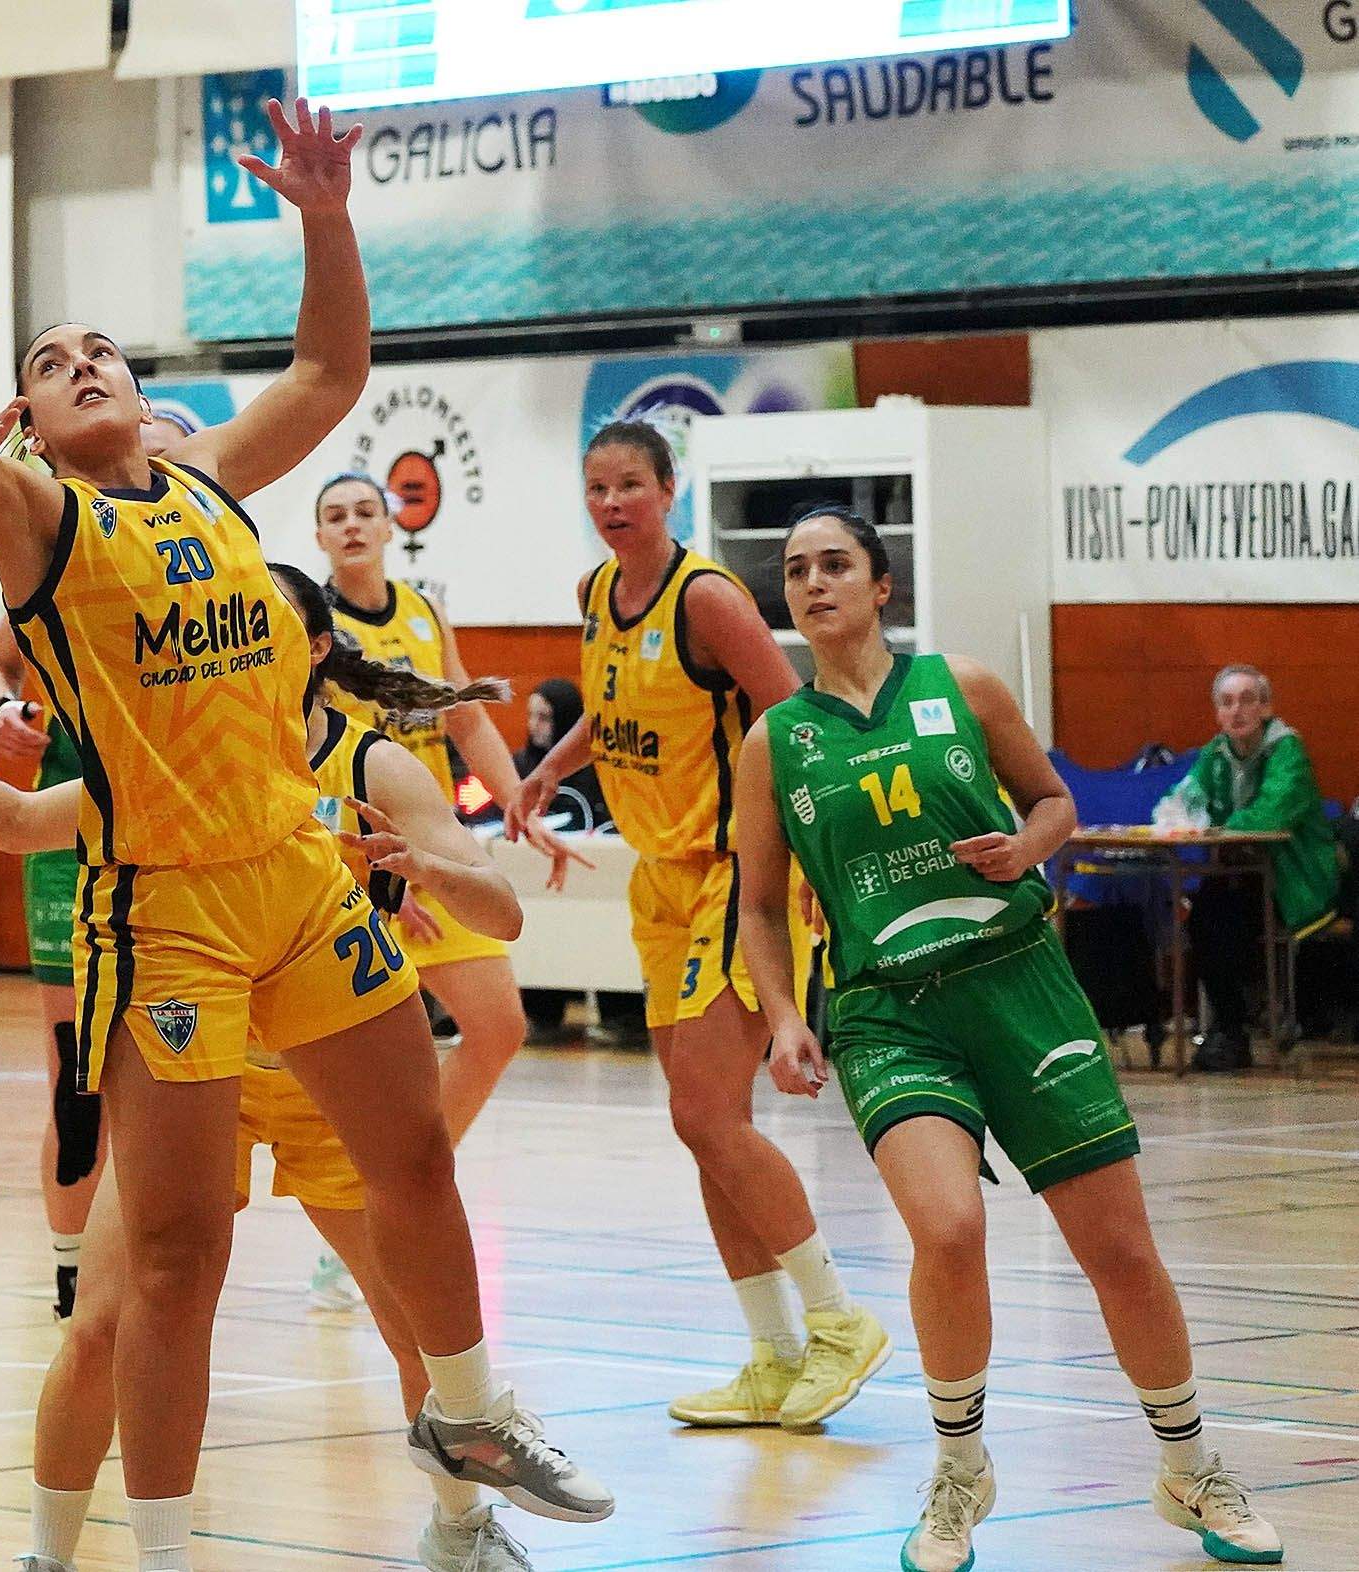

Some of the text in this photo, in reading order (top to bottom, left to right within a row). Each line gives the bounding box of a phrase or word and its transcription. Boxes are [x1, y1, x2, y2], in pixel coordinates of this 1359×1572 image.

[1323, 0, 1357, 43] G
[790, 42, 1055, 127] SAUDABLE
[367, 106, 557, 183] GALICIA
[143, 510, 182, 529] vive
[1063, 478, 1359, 560] VISIT-PONTEVEDRA.GA
[155, 537, 215, 586] 20
[134, 592, 270, 665] Melilla
[141, 647, 275, 688] CIUDAD DEL DEPORTE
[859, 763, 921, 827] 14
[884, 838, 943, 867] XUNTA
[889, 866, 913, 884] DE
[333, 907, 405, 998] 20
[876, 925, 1004, 970] sit-pontevedra.com
[681, 957, 702, 999] 3
